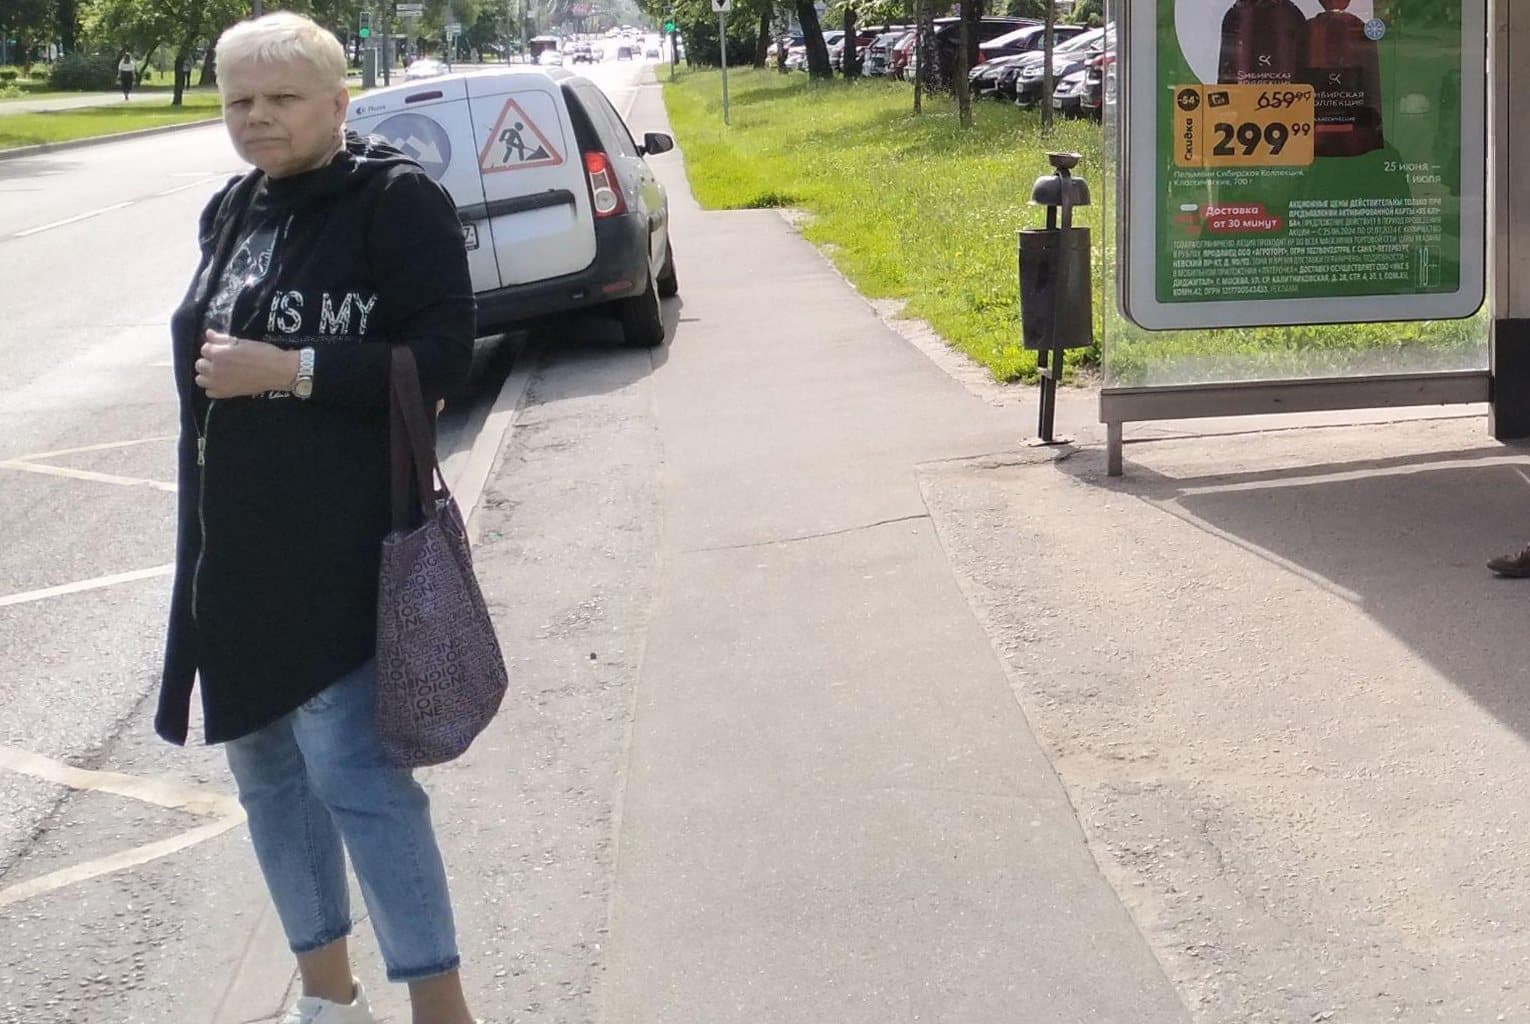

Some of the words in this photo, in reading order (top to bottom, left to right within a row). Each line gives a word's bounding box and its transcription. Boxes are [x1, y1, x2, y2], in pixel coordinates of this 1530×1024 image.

[1184, 118, 1193, 161] Скидка
[1384, 162, 1396, 172] 25
[1399, 162, 1428, 172] июня
[1412, 175, 1441, 184] июля
[1206, 206, 1259, 217] Доставка
[1213, 220, 1226, 228] от
[1228, 219, 1240, 228] 30
[1243, 219, 1277, 229] минут
[267, 290, 304, 334] IS
[319, 292, 378, 335] MY
